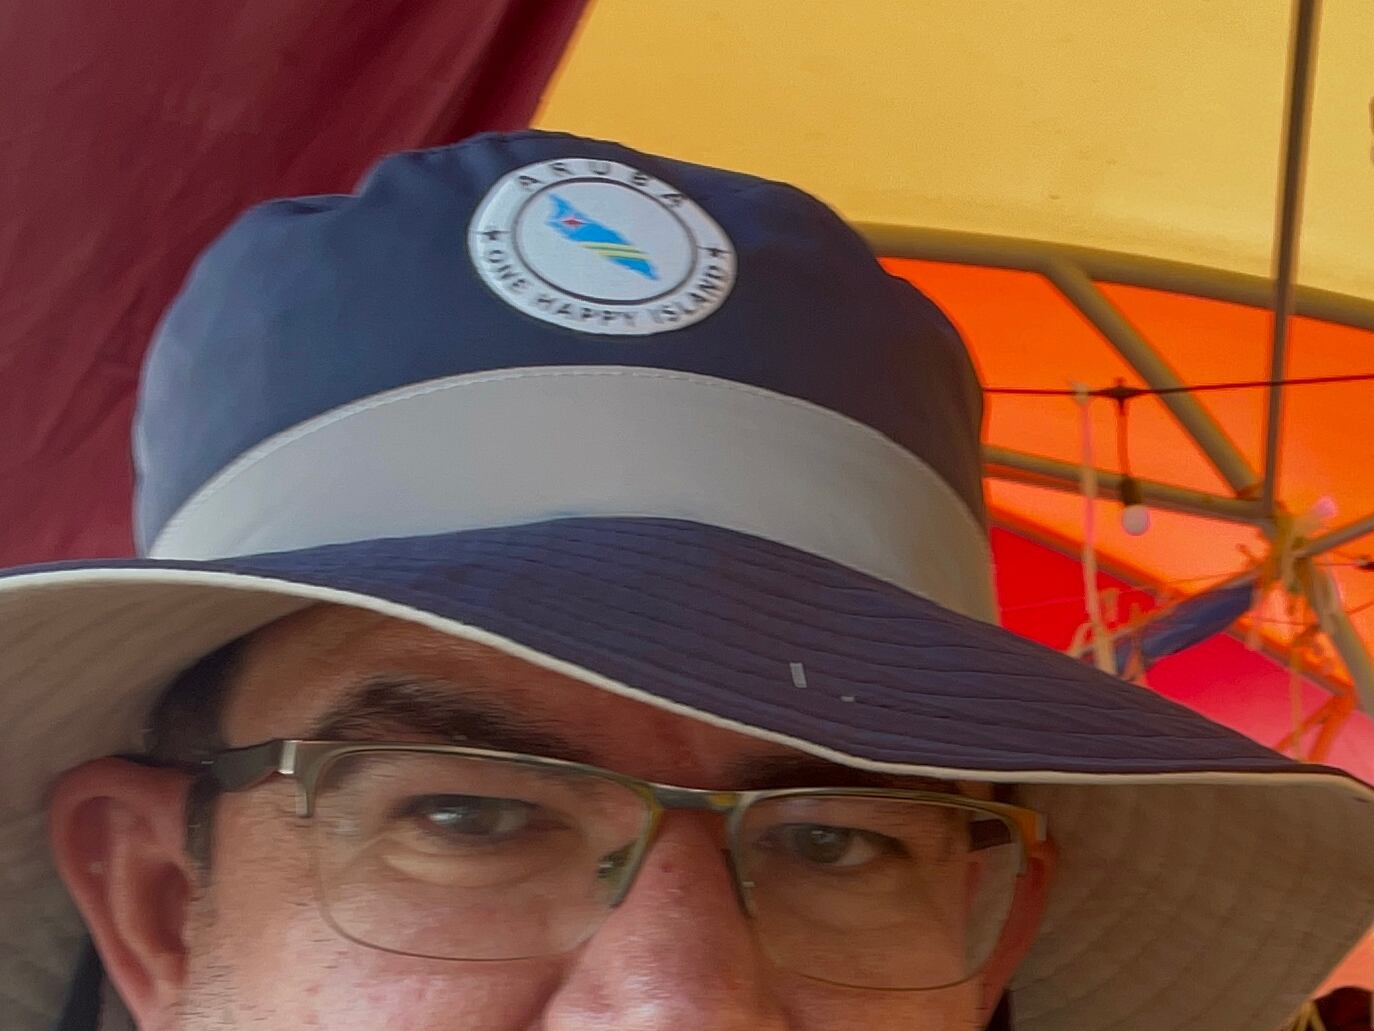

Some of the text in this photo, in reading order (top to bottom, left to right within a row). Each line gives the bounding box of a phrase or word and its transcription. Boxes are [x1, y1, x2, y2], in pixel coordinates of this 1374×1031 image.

[517, 160, 690, 209] ARUBA
[488, 249, 725, 327] ONE HAPPY ISLAND
